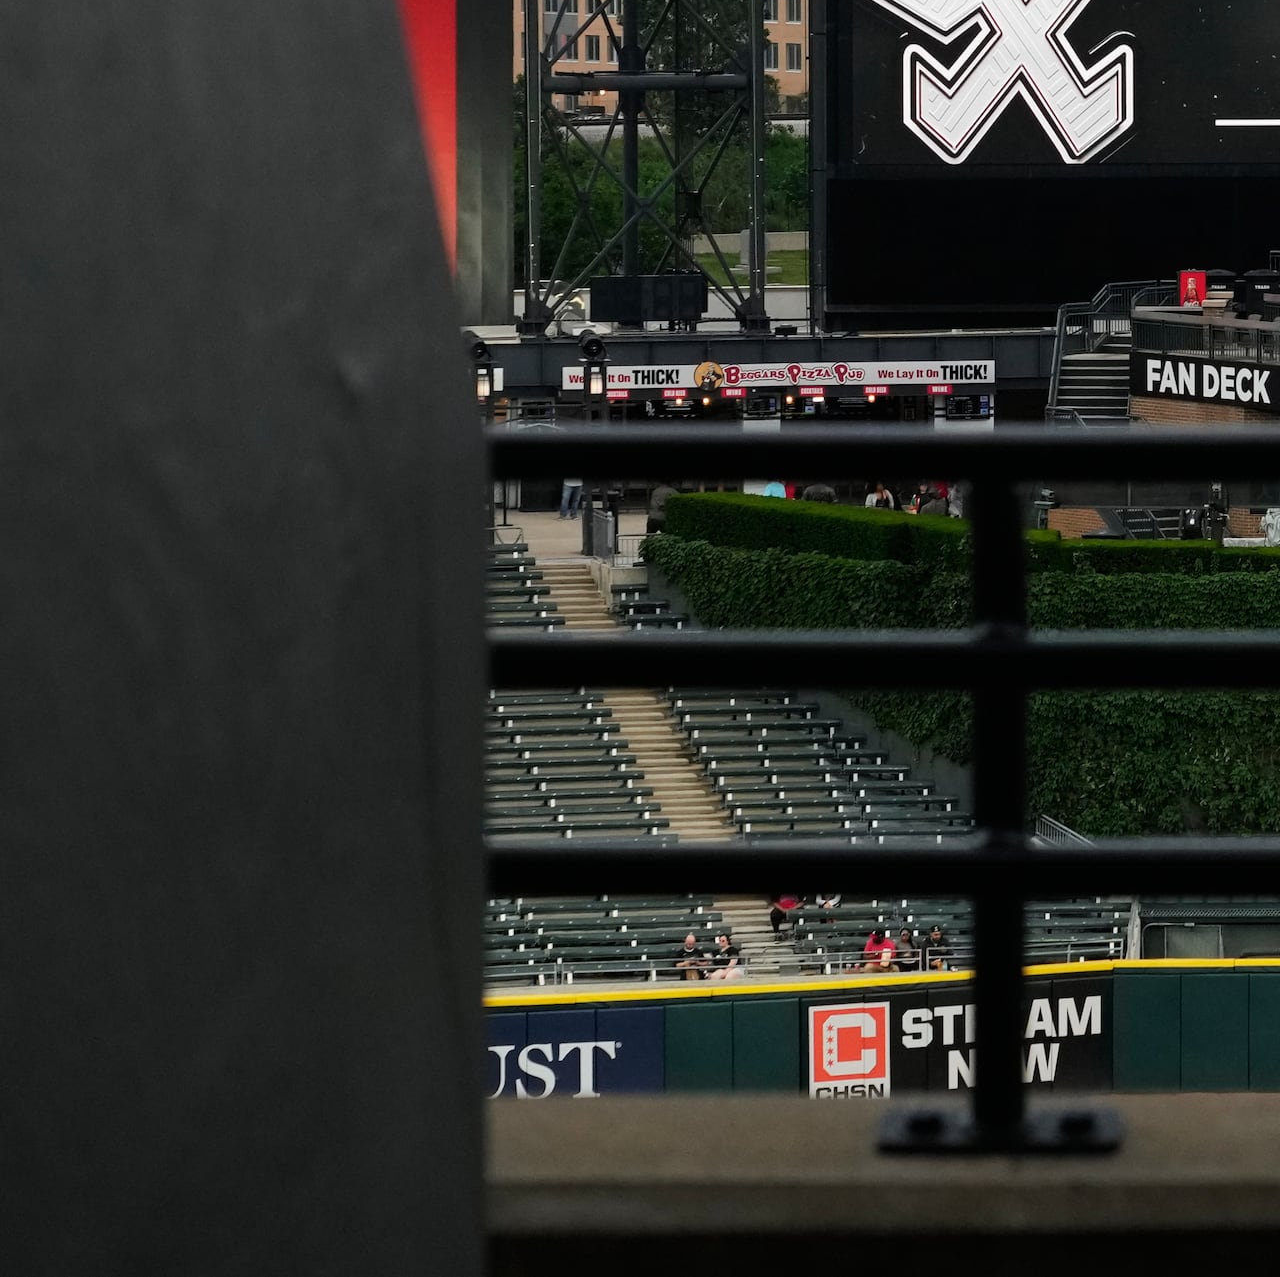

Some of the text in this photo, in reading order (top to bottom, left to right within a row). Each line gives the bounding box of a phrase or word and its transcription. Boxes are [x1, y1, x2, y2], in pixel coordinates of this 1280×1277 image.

[569, 369, 680, 384] We It On THICK!
[878, 364, 988, 380] We Lay It On THICK!
[1146, 359, 1271, 404] FAN DECK
[902, 996, 1102, 1048] STAM
[948, 1043, 1060, 1090] NW
[815, 1083, 884, 1100] CHSN
